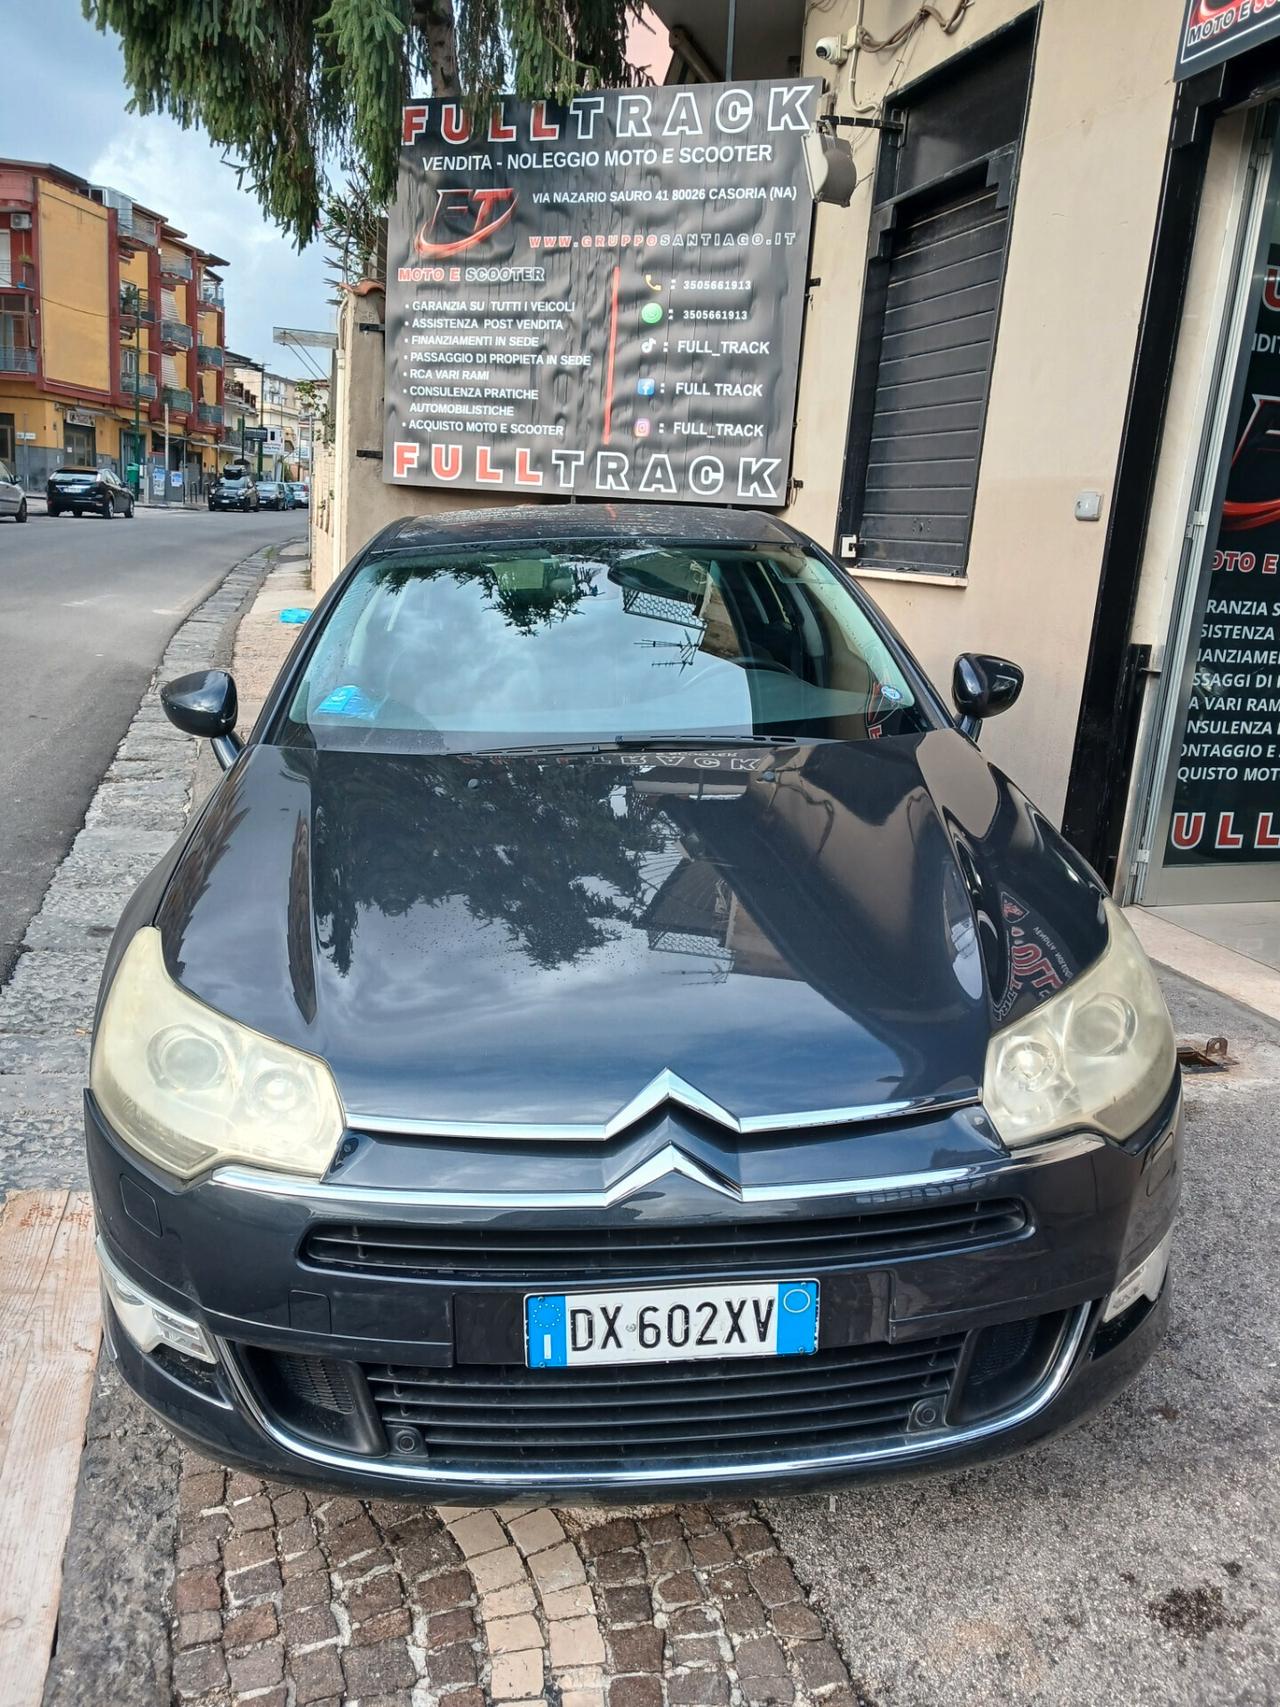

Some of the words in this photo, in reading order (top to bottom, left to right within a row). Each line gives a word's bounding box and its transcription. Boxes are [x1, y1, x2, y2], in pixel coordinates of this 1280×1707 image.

[1187, 7, 1235, 47] MOTO
[422, 154, 492, 171] VENDITA
[507, 151, 600, 170] NOLEGGIO
[604, 149, 658, 167] MOTO
[662, 147, 674, 164] E
[679, 144, 773, 164] SCOOTER
[532, 192, 550, 204] VIA
[553, 191, 607, 203] NAZARIO
[610, 190, 652, 202] SAURO
[655, 190, 669, 201] 41
[672, 189, 705, 200] 80026
[709, 187, 767, 200] CASORIA
[770, 186, 797, 200] (NA)
[528, 232, 796, 248] WWW.GRUPPOSANTIAGO.IT
[398, 267, 444, 282] MOTO
[450, 267, 461, 281] E
[465, 266, 545, 282] SCOOTER
[683, 280, 751, 290] 3505661913
[412, 301, 467, 312] GARANZIA
[470, 301, 485, 312] SU
[491, 301, 521, 312] TUTTI
[524, 301, 528, 312] I
[530, 301, 576, 312] VEICOLI
[683, 310, 748, 320] 3505661913
[412, 318, 479, 329] ASSISTENZA
[484, 319, 513, 329] POST
[516, 319, 563, 330] VENDITA
[411, 335, 492, 346] FINANZIAMENTI
[495, 336, 506, 346] IN
[508, 336, 539, 347] SEDE
[677, 340, 770, 356] FULL_TRACK
[410, 352, 474, 363] PASSAGGIO
[476, 353, 487, 363] DI
[489, 353, 544, 365] PROPIETA
[547, 355, 557, 365] IN
[560, 355, 592, 366] SEDE
[410, 369, 432, 379] RCA
[435, 370, 460, 380] VARI
[462, 370, 490, 380] RAMI
[410, 386, 482, 398] CONSULENZA
[484, 388, 539, 400] PRATICHE
[675, 382, 710, 396] FULL
[714, 383, 763, 397] TRACK
[409, 403, 514, 416] AUTOMOBILISTICHE
[409, 419, 464, 432] ACQUISTO
[466, 421, 497, 433] MOTO
[500, 423, 508, 433] E
[510, 424, 564, 436] SCOOTER
[673, 421, 764, 438] FULL_TRACK
[1262, 553, 1279, 574] E
[1197, 648, 1280, 664] ANZIAME
[1255, 674, 1273, 688] DI
[1204, 696, 1242, 711] VARI
[1186, 720, 1273, 735] NSULENZA
[1266, 744, 1277, 757] E
[1177, 766, 1239, 782] QUISTO
[569, 1303, 624, 1352] DX
[637, 1297, 775, 1349] 602XV
